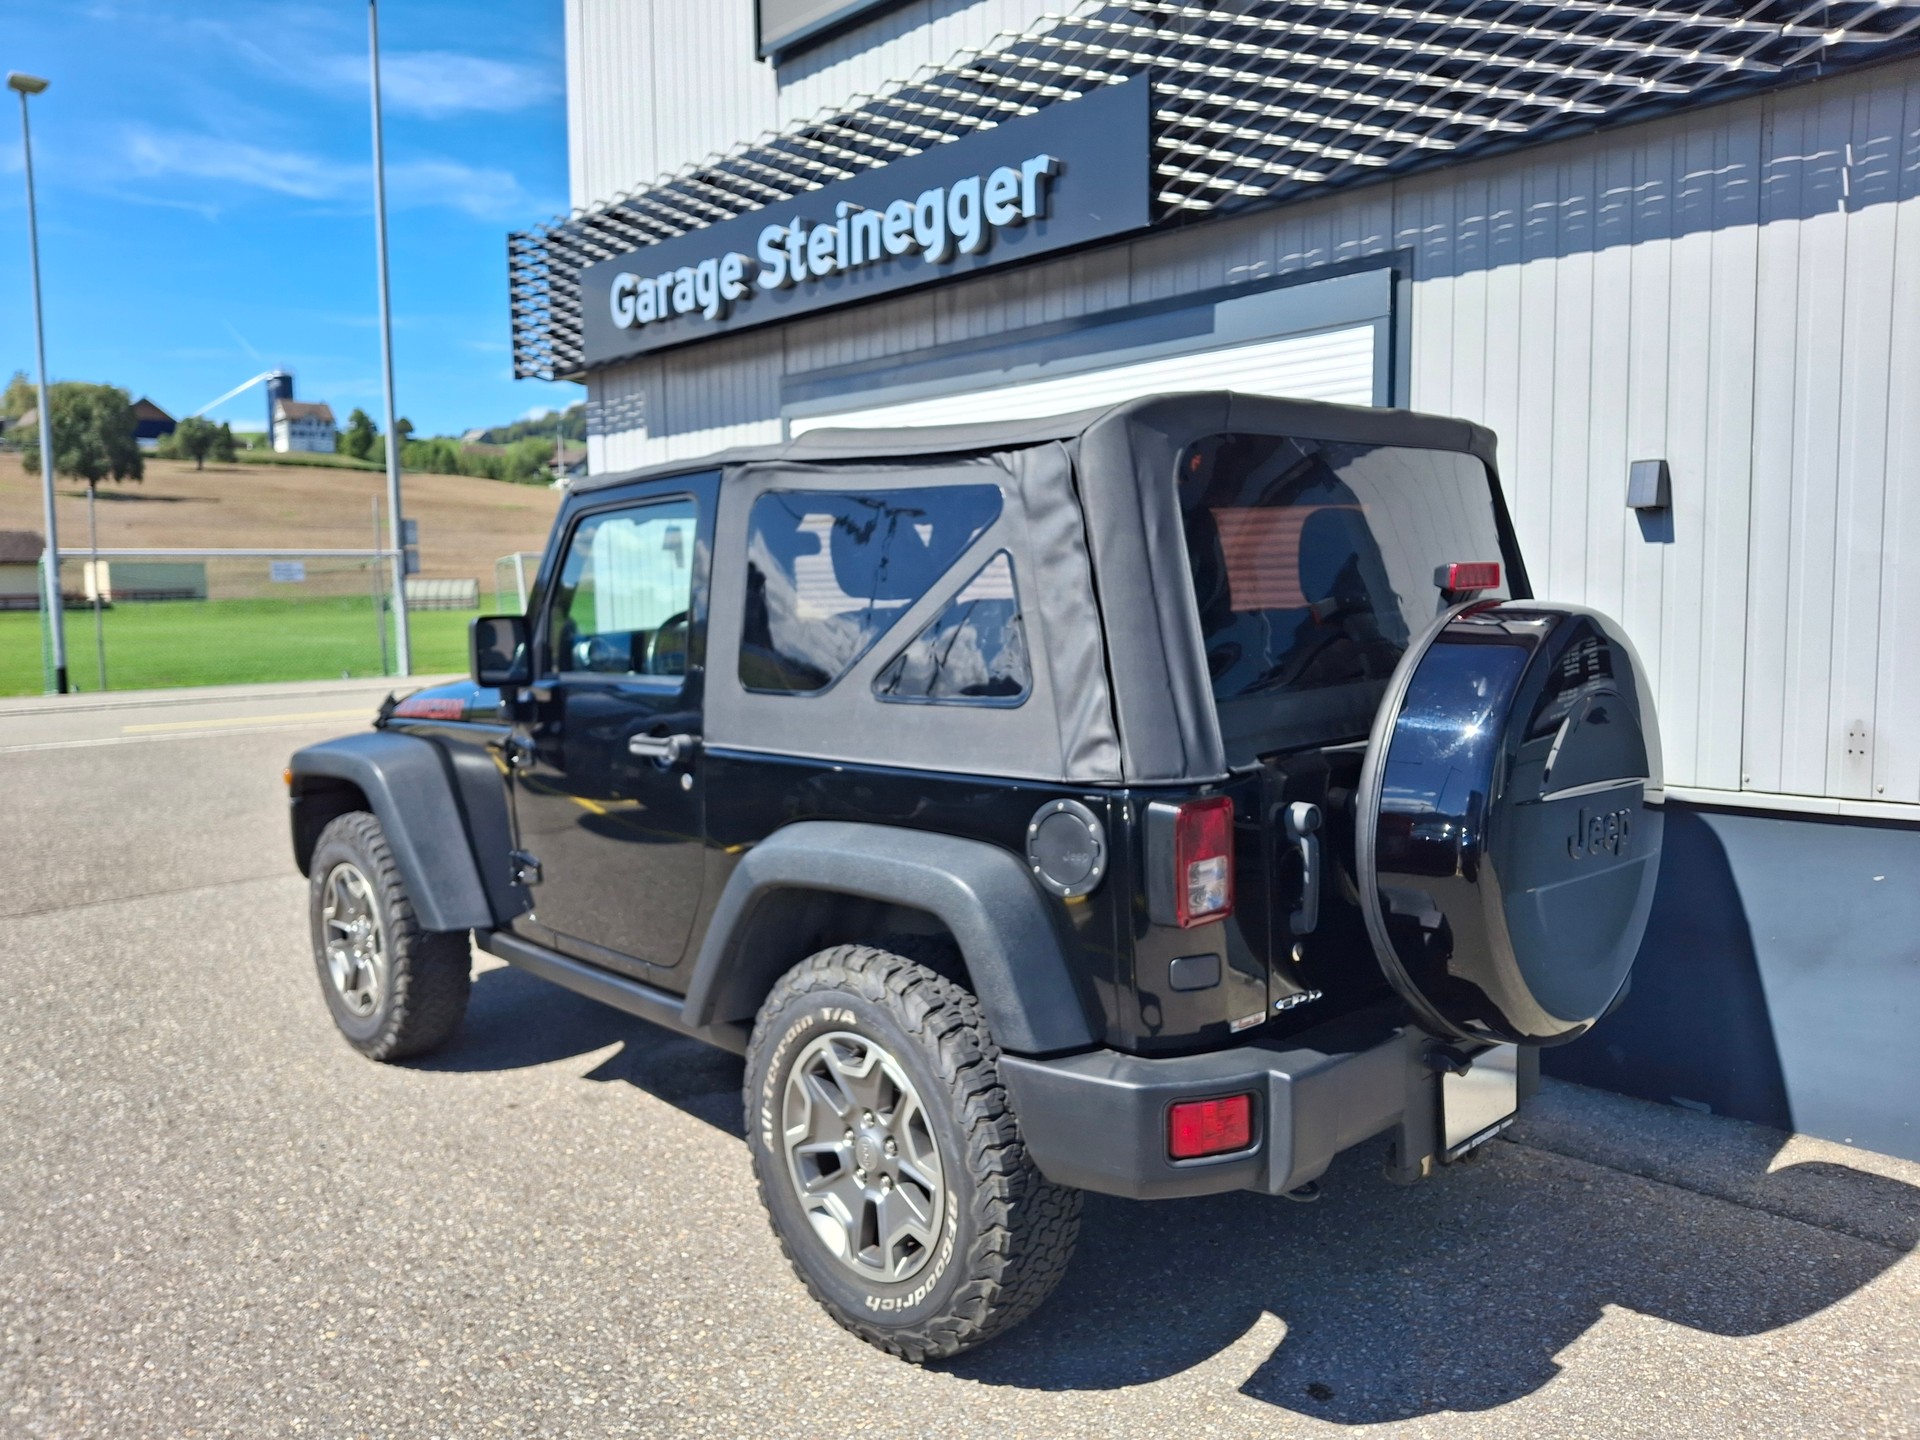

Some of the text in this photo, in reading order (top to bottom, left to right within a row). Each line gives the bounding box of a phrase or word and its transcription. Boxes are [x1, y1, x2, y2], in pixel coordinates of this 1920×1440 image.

[609, 153, 1054, 330] Garage Steinegger
[1568, 806, 1632, 860] Jeep
[820, 1007, 857, 1025] T/A
